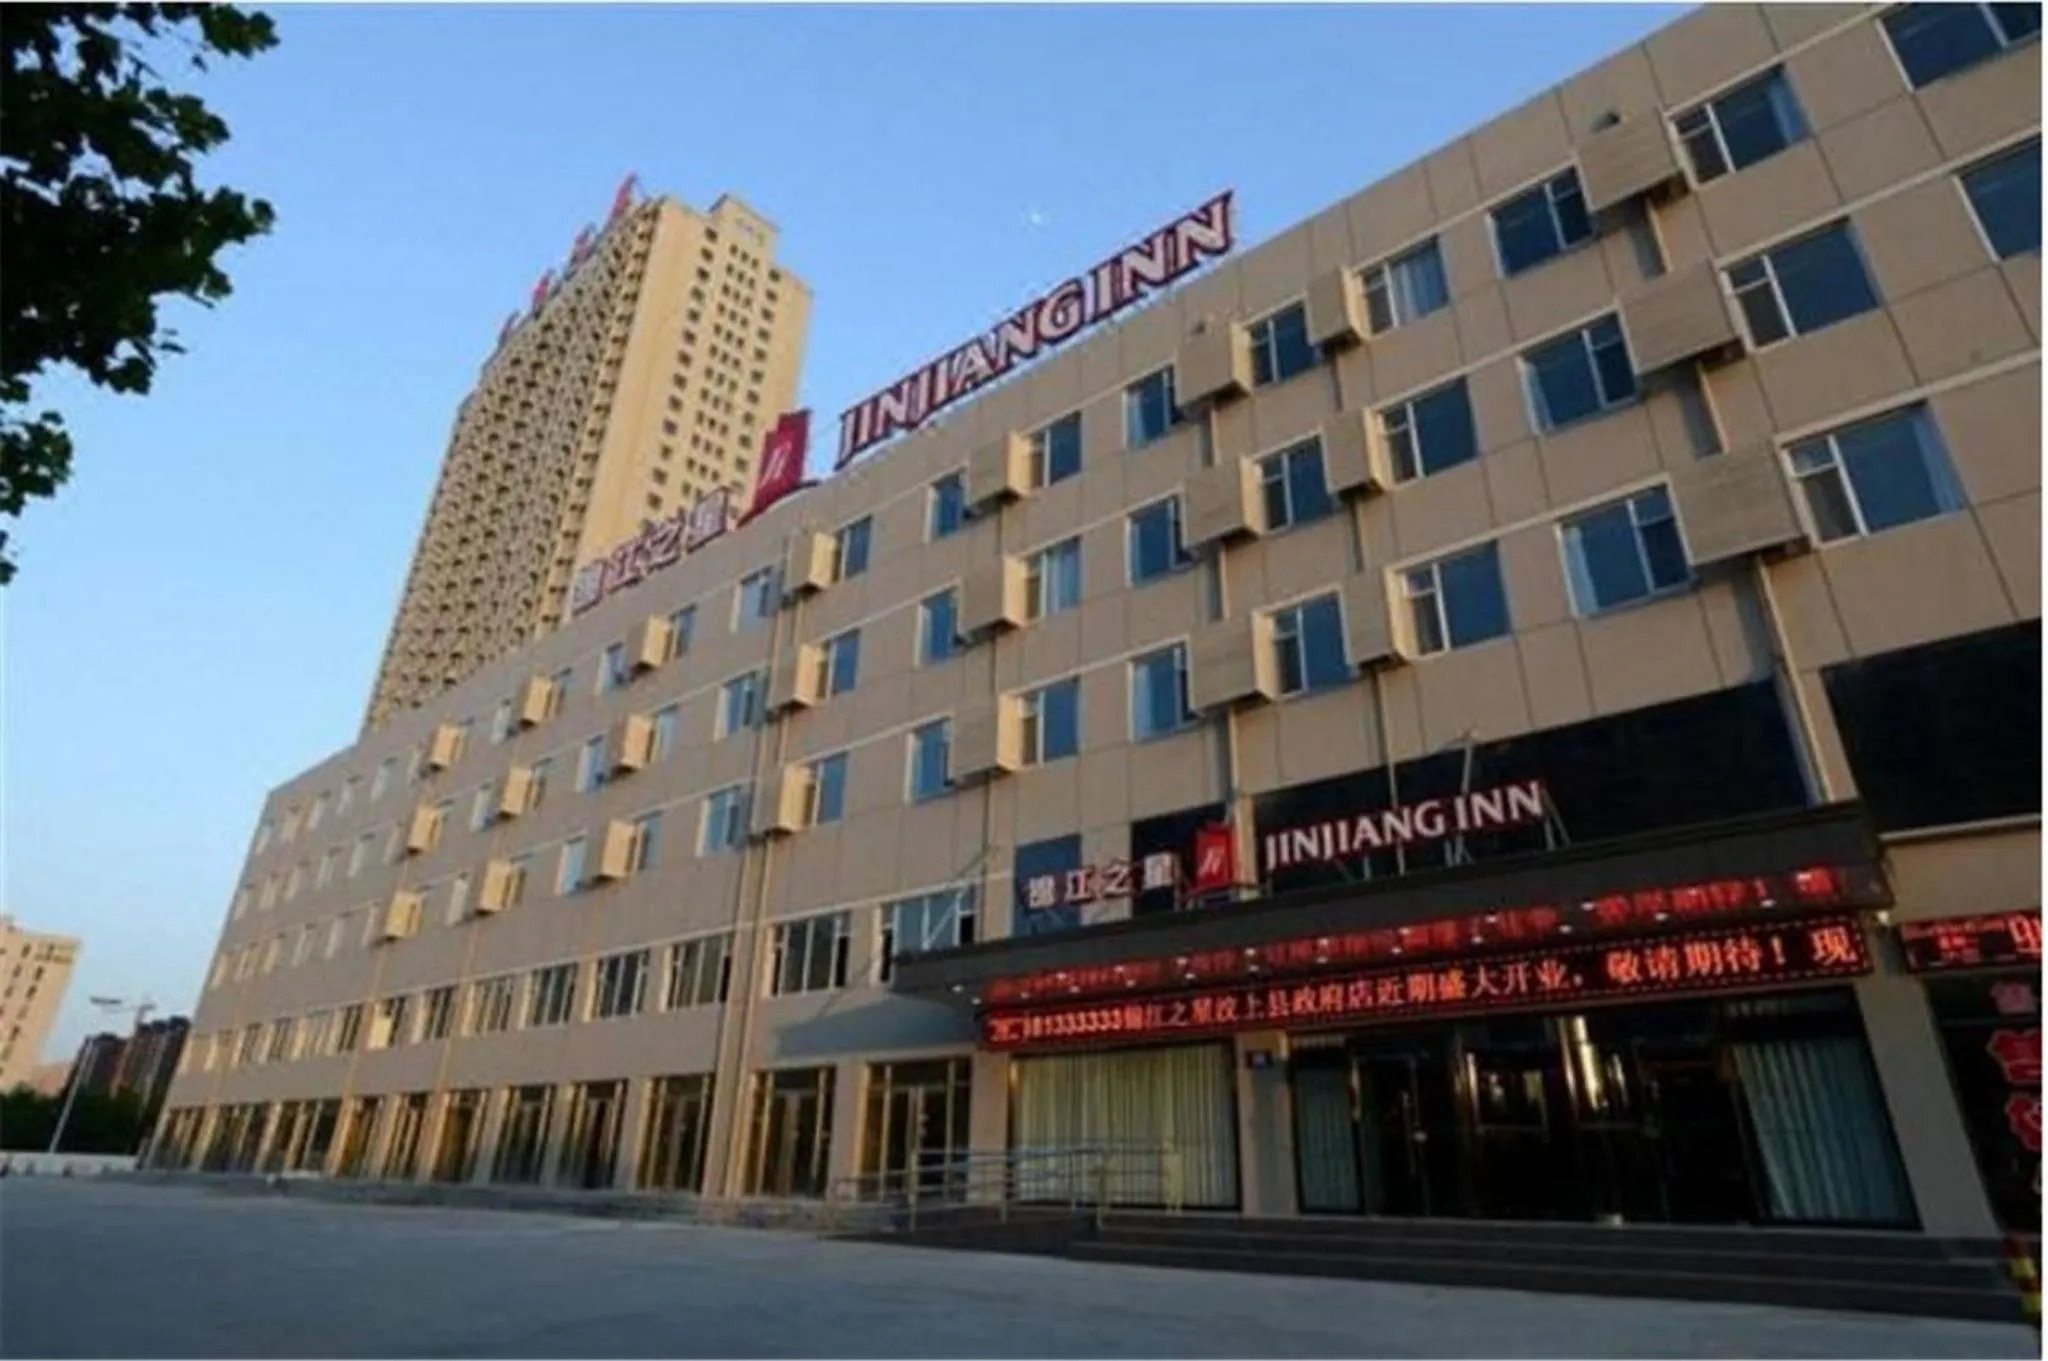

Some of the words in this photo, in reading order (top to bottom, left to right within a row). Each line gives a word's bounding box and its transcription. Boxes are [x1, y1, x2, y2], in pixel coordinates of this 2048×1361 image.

[835, 276, 1087, 470] JINJIANG
[1085, 189, 1233, 322] INN
[1264, 801, 1446, 871] JINJIANG
[1453, 780, 1544, 831] INN
